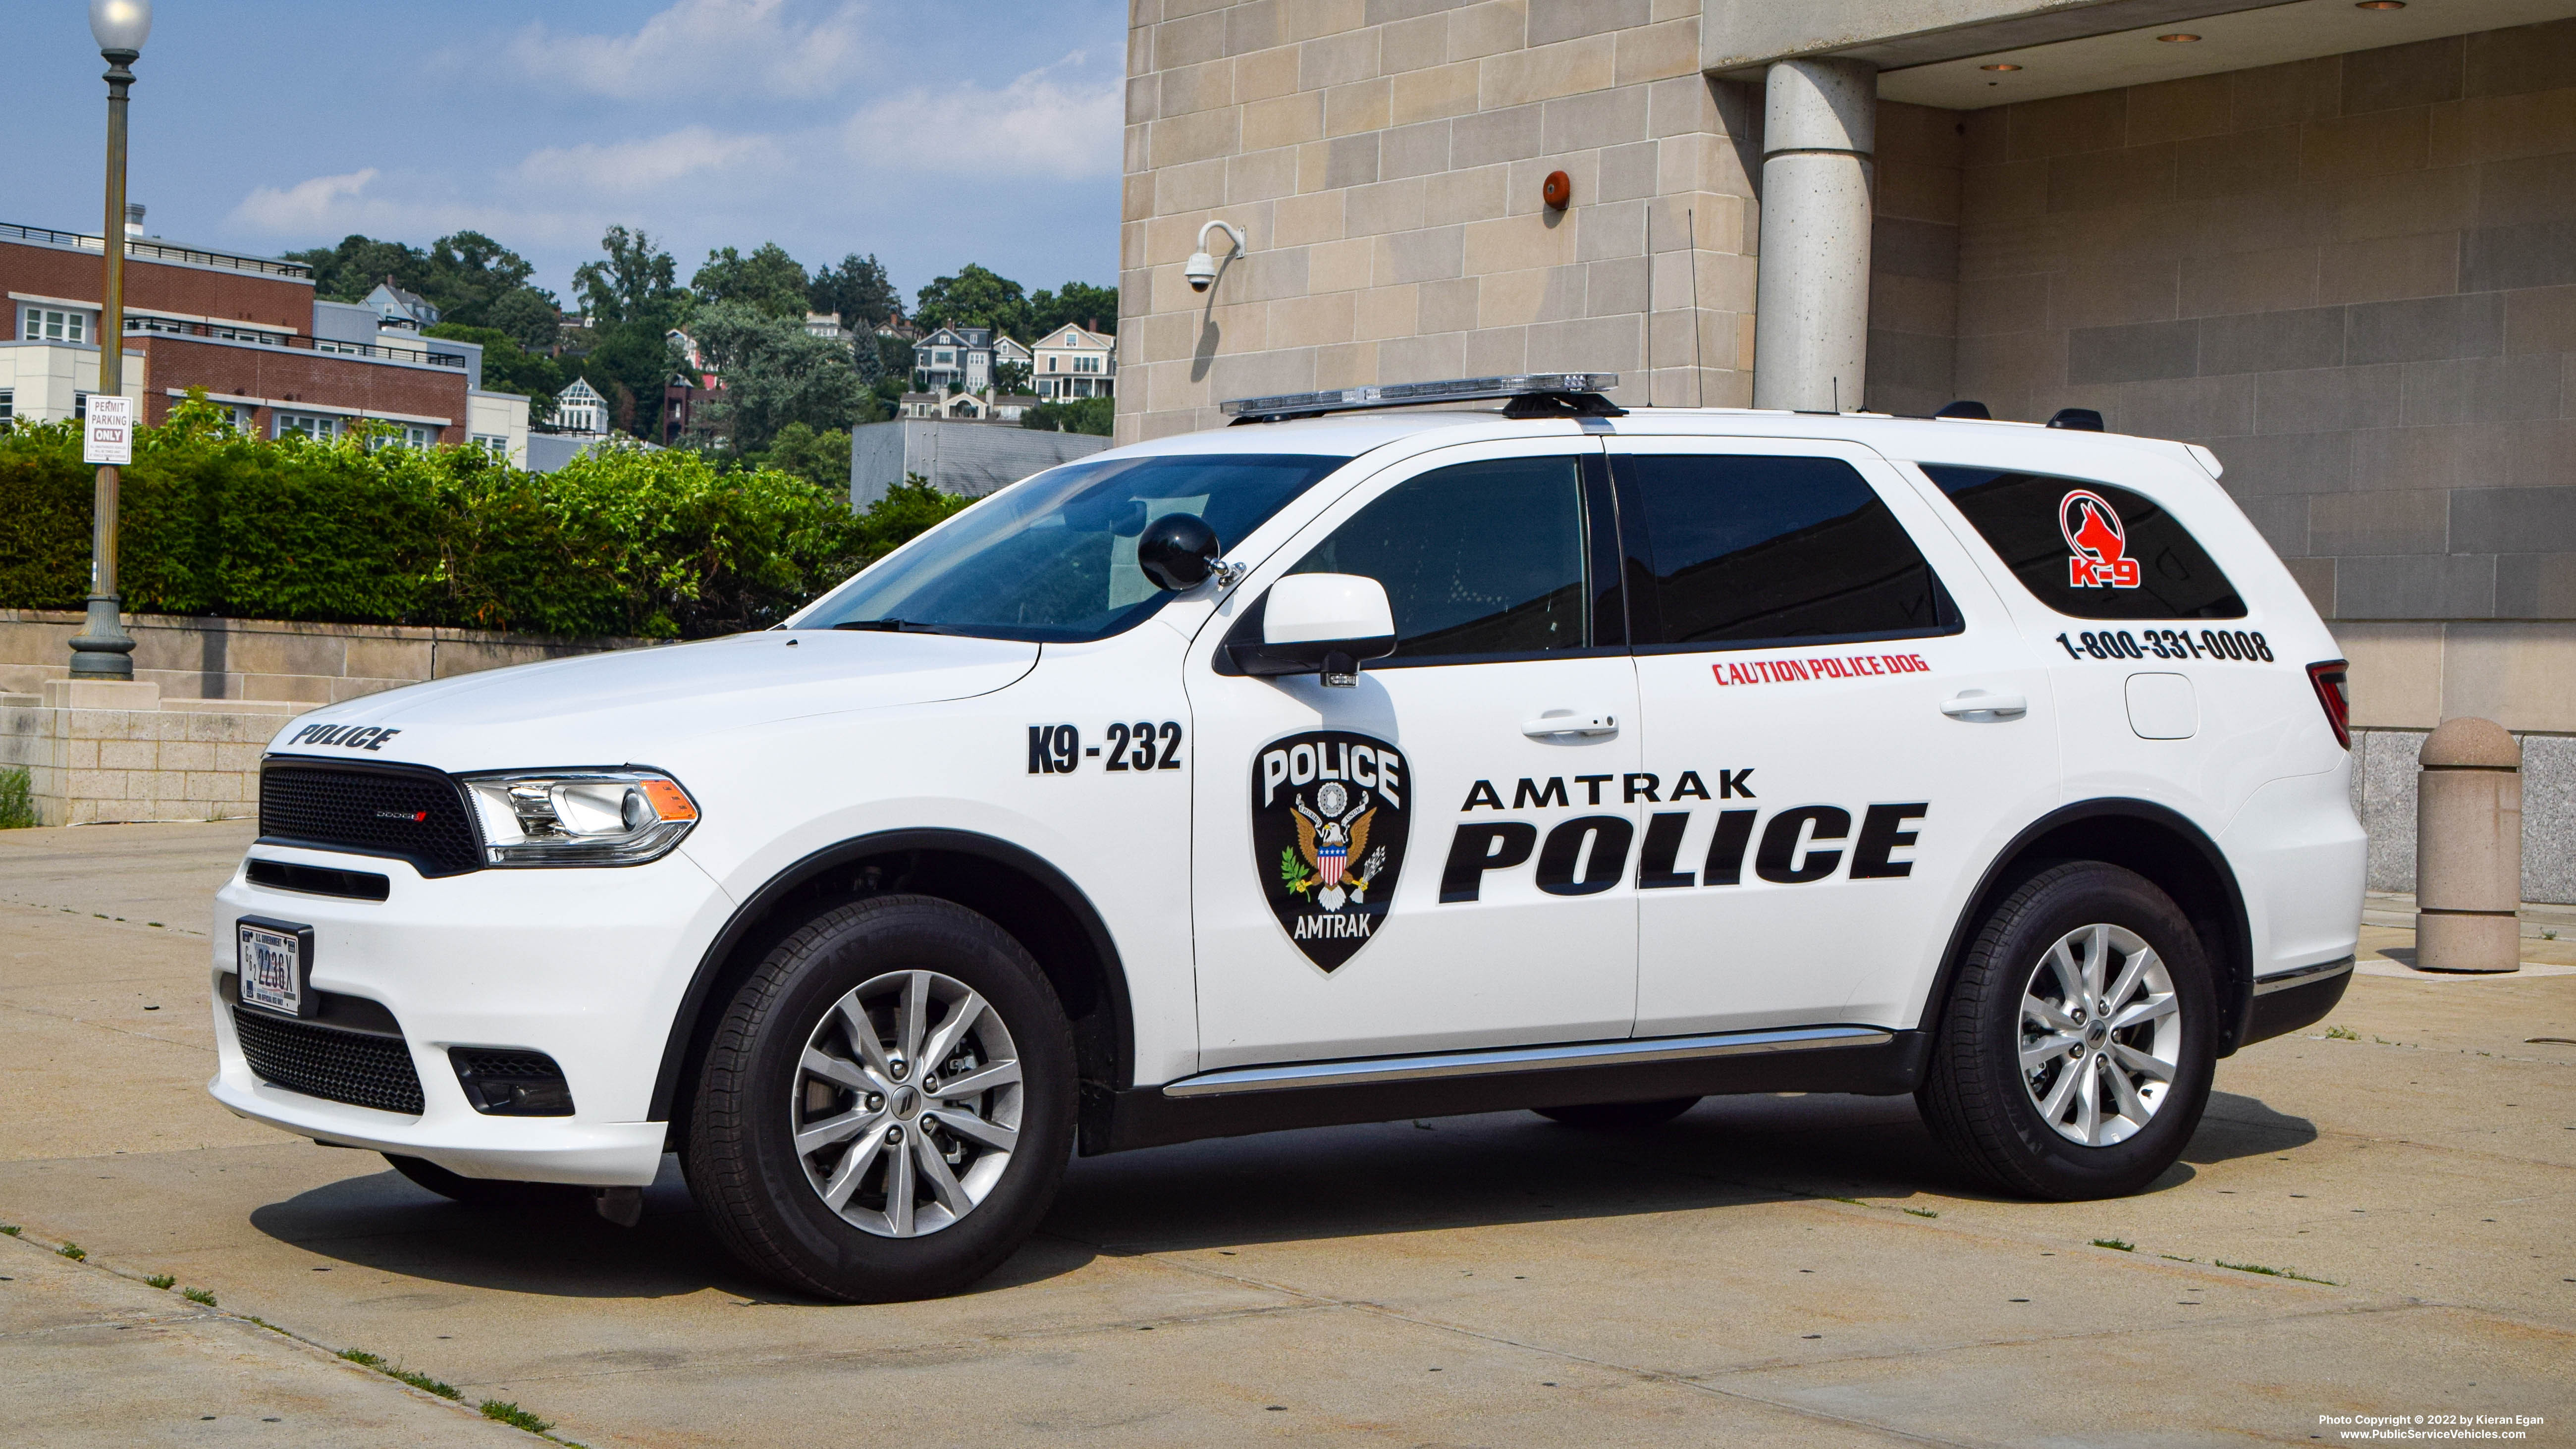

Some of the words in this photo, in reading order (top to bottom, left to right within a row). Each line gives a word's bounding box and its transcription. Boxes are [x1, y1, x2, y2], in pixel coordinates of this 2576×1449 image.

[92, 415, 127, 426] PARKING
[95, 402, 125, 412] PERMIT
[96, 429, 121, 441] ONLY
[2072, 558, 2139, 586] K-9
[2056, 630, 2274, 662] 1-800-331-0008
[1712, 659, 1810, 686] CAUTION
[1808, 656, 1885, 679] POLICE
[1882, 654, 1930, 674] DOG
[288, 724, 402, 751] POLICE
[1263, 742, 1399, 809] POLICE
[1460, 768, 1757, 812] AMTRAK
[376, 810, 419, 821] DODGE
[1303, 808, 1322, 825] PLURIBUS
[1345, 807, 1361, 821] UNUM
[1438, 802, 1929, 904] POLICE
[1294, 913, 1371, 939] AMTRAK
[262, 934, 281, 947] GOVERNMENT
[259, 949, 292, 992] 2236X
